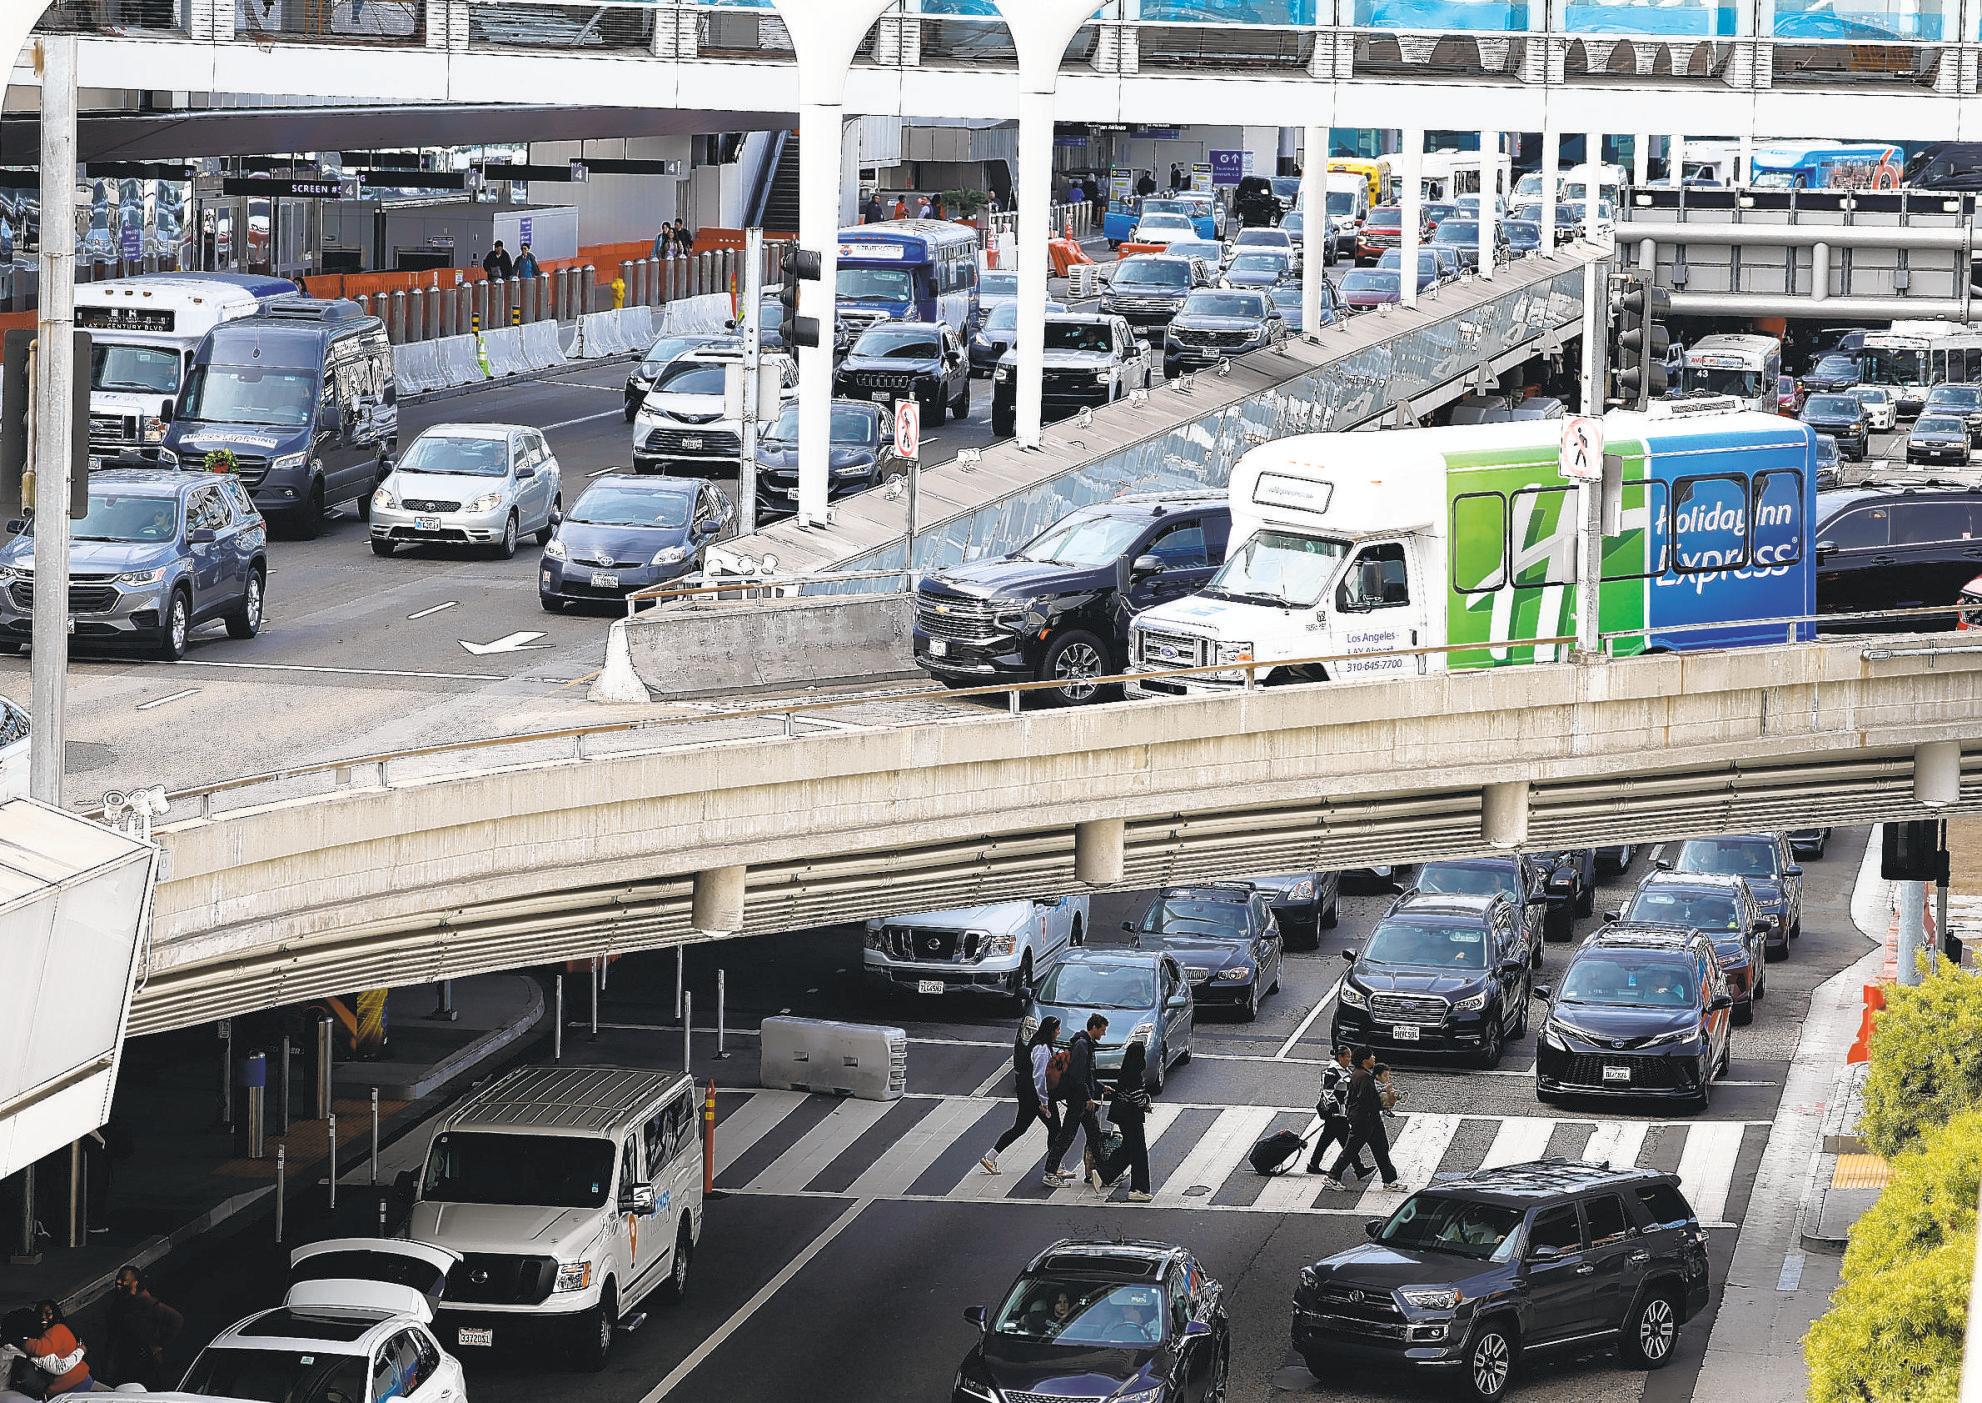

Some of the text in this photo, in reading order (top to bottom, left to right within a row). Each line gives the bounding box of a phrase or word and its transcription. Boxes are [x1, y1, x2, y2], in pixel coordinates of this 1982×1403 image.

[668, 162, 675, 173] 4
[574, 169, 582, 180] 4
[468, 175, 477, 187] 4
[291, 184, 328, 193] SCREEN
[345, 184, 354, 196] 4
[107, 323, 142, 331] CENTURY
[144, 324, 164, 332] BLVD
[1696, 369, 1709, 378] 43
[1655, 499, 1792, 536] Holiday Inn
[1655, 542, 1792, 595] Express
[1347, 634, 1361, 643] Los
[1362, 631, 1396, 643] Angeles
[1346, 659, 1403, 672] 310-645-7700
